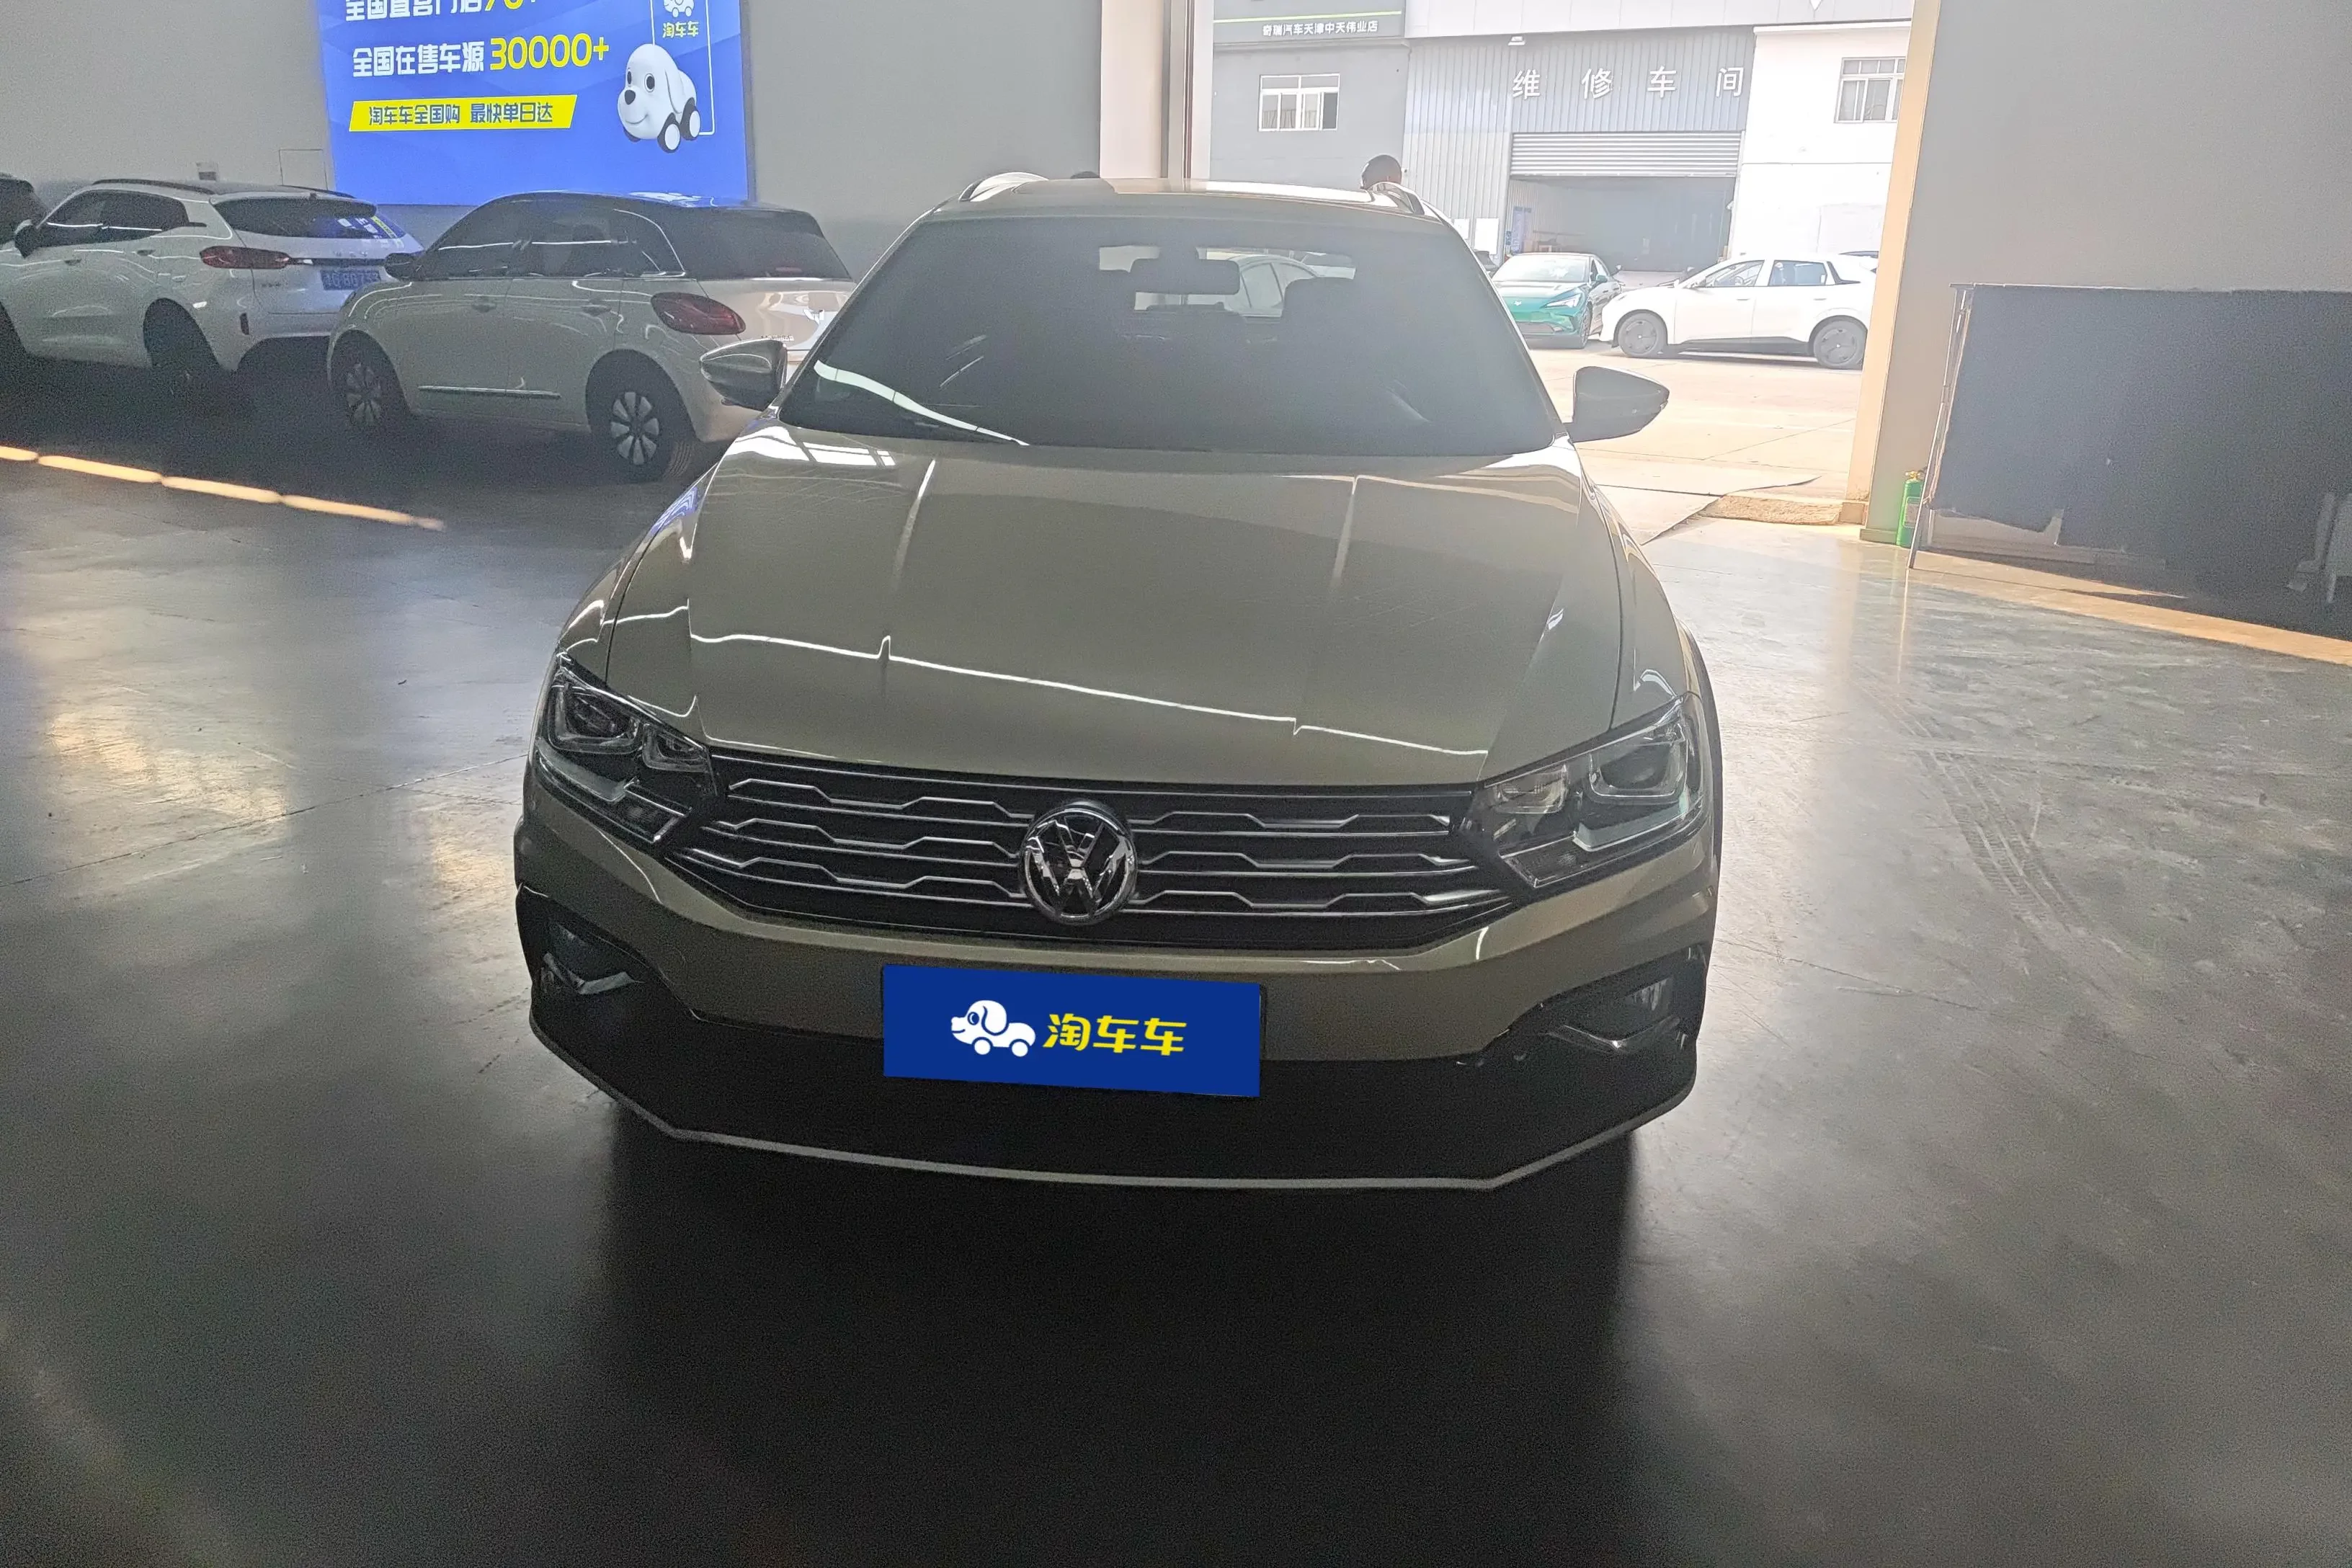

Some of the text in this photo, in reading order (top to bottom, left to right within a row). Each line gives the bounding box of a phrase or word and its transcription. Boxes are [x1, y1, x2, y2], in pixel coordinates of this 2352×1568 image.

[662, 20, 700, 38] 淘车车
[352, 33, 610, 78] 全国在售车源 30000+
[1512, 66, 1744, 99] 维修车间
[369, 102, 553, 125] 淘车车全国购 最快单日达
[1043, 1013, 1187, 1056] 淘车车
